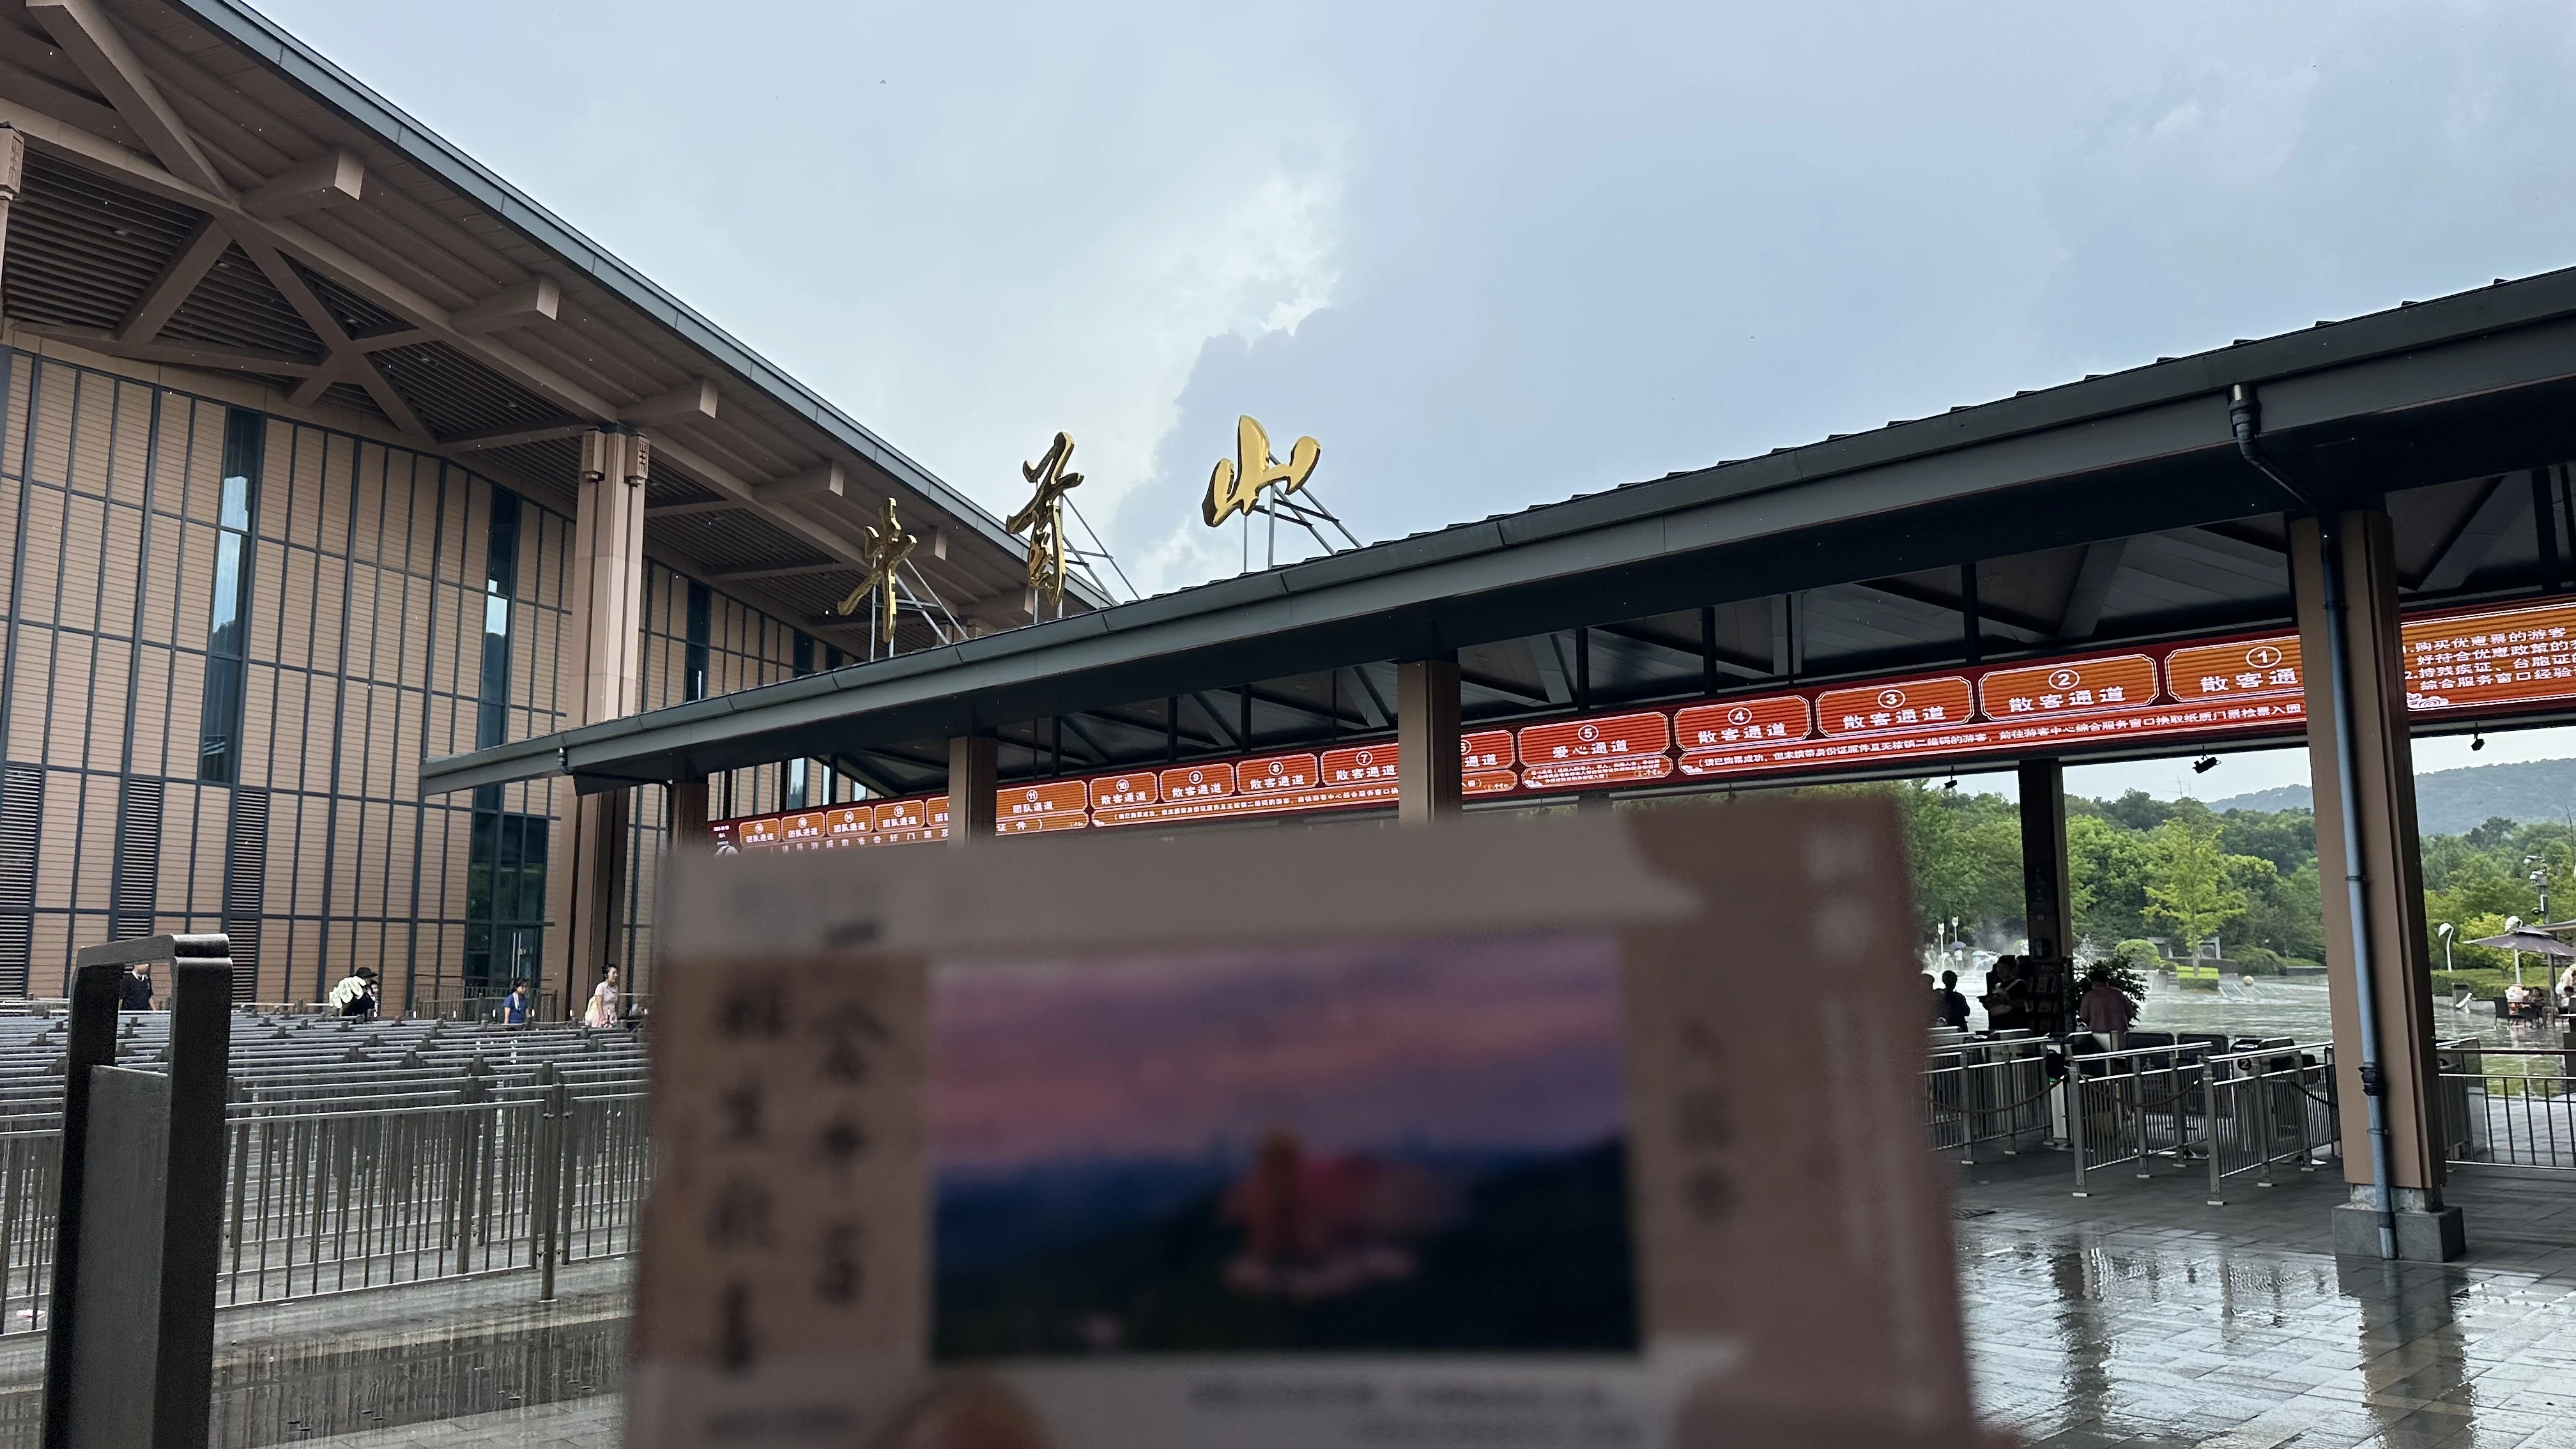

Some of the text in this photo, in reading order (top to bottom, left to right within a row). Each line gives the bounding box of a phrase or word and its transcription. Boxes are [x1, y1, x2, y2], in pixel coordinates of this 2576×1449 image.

[2405, 652, 2576, 680] 2.持残疾证、台胞证
[2200, 668, 2299, 692] 散客通
[2420, 666, 2576, 691] 综合服务窗口经验
[2009, 686, 2126, 712] 散客通道
[1843, 706, 1946, 729] 散客通道
[1698, 723, 1787, 744] 散客通道
[1552, 740, 1629, 758] 爱心通道
[1336, 764, 1396, 781] 散客通道
[1172, 783, 1222, 797] 散客通道
[1250, 774, 1305, 790] 散客通道
[1013, 801, 1054, 813] 团队通道
[1101, 791, 1146, 805] 散客通道
[882, 816, 917, 828] 团队通道
